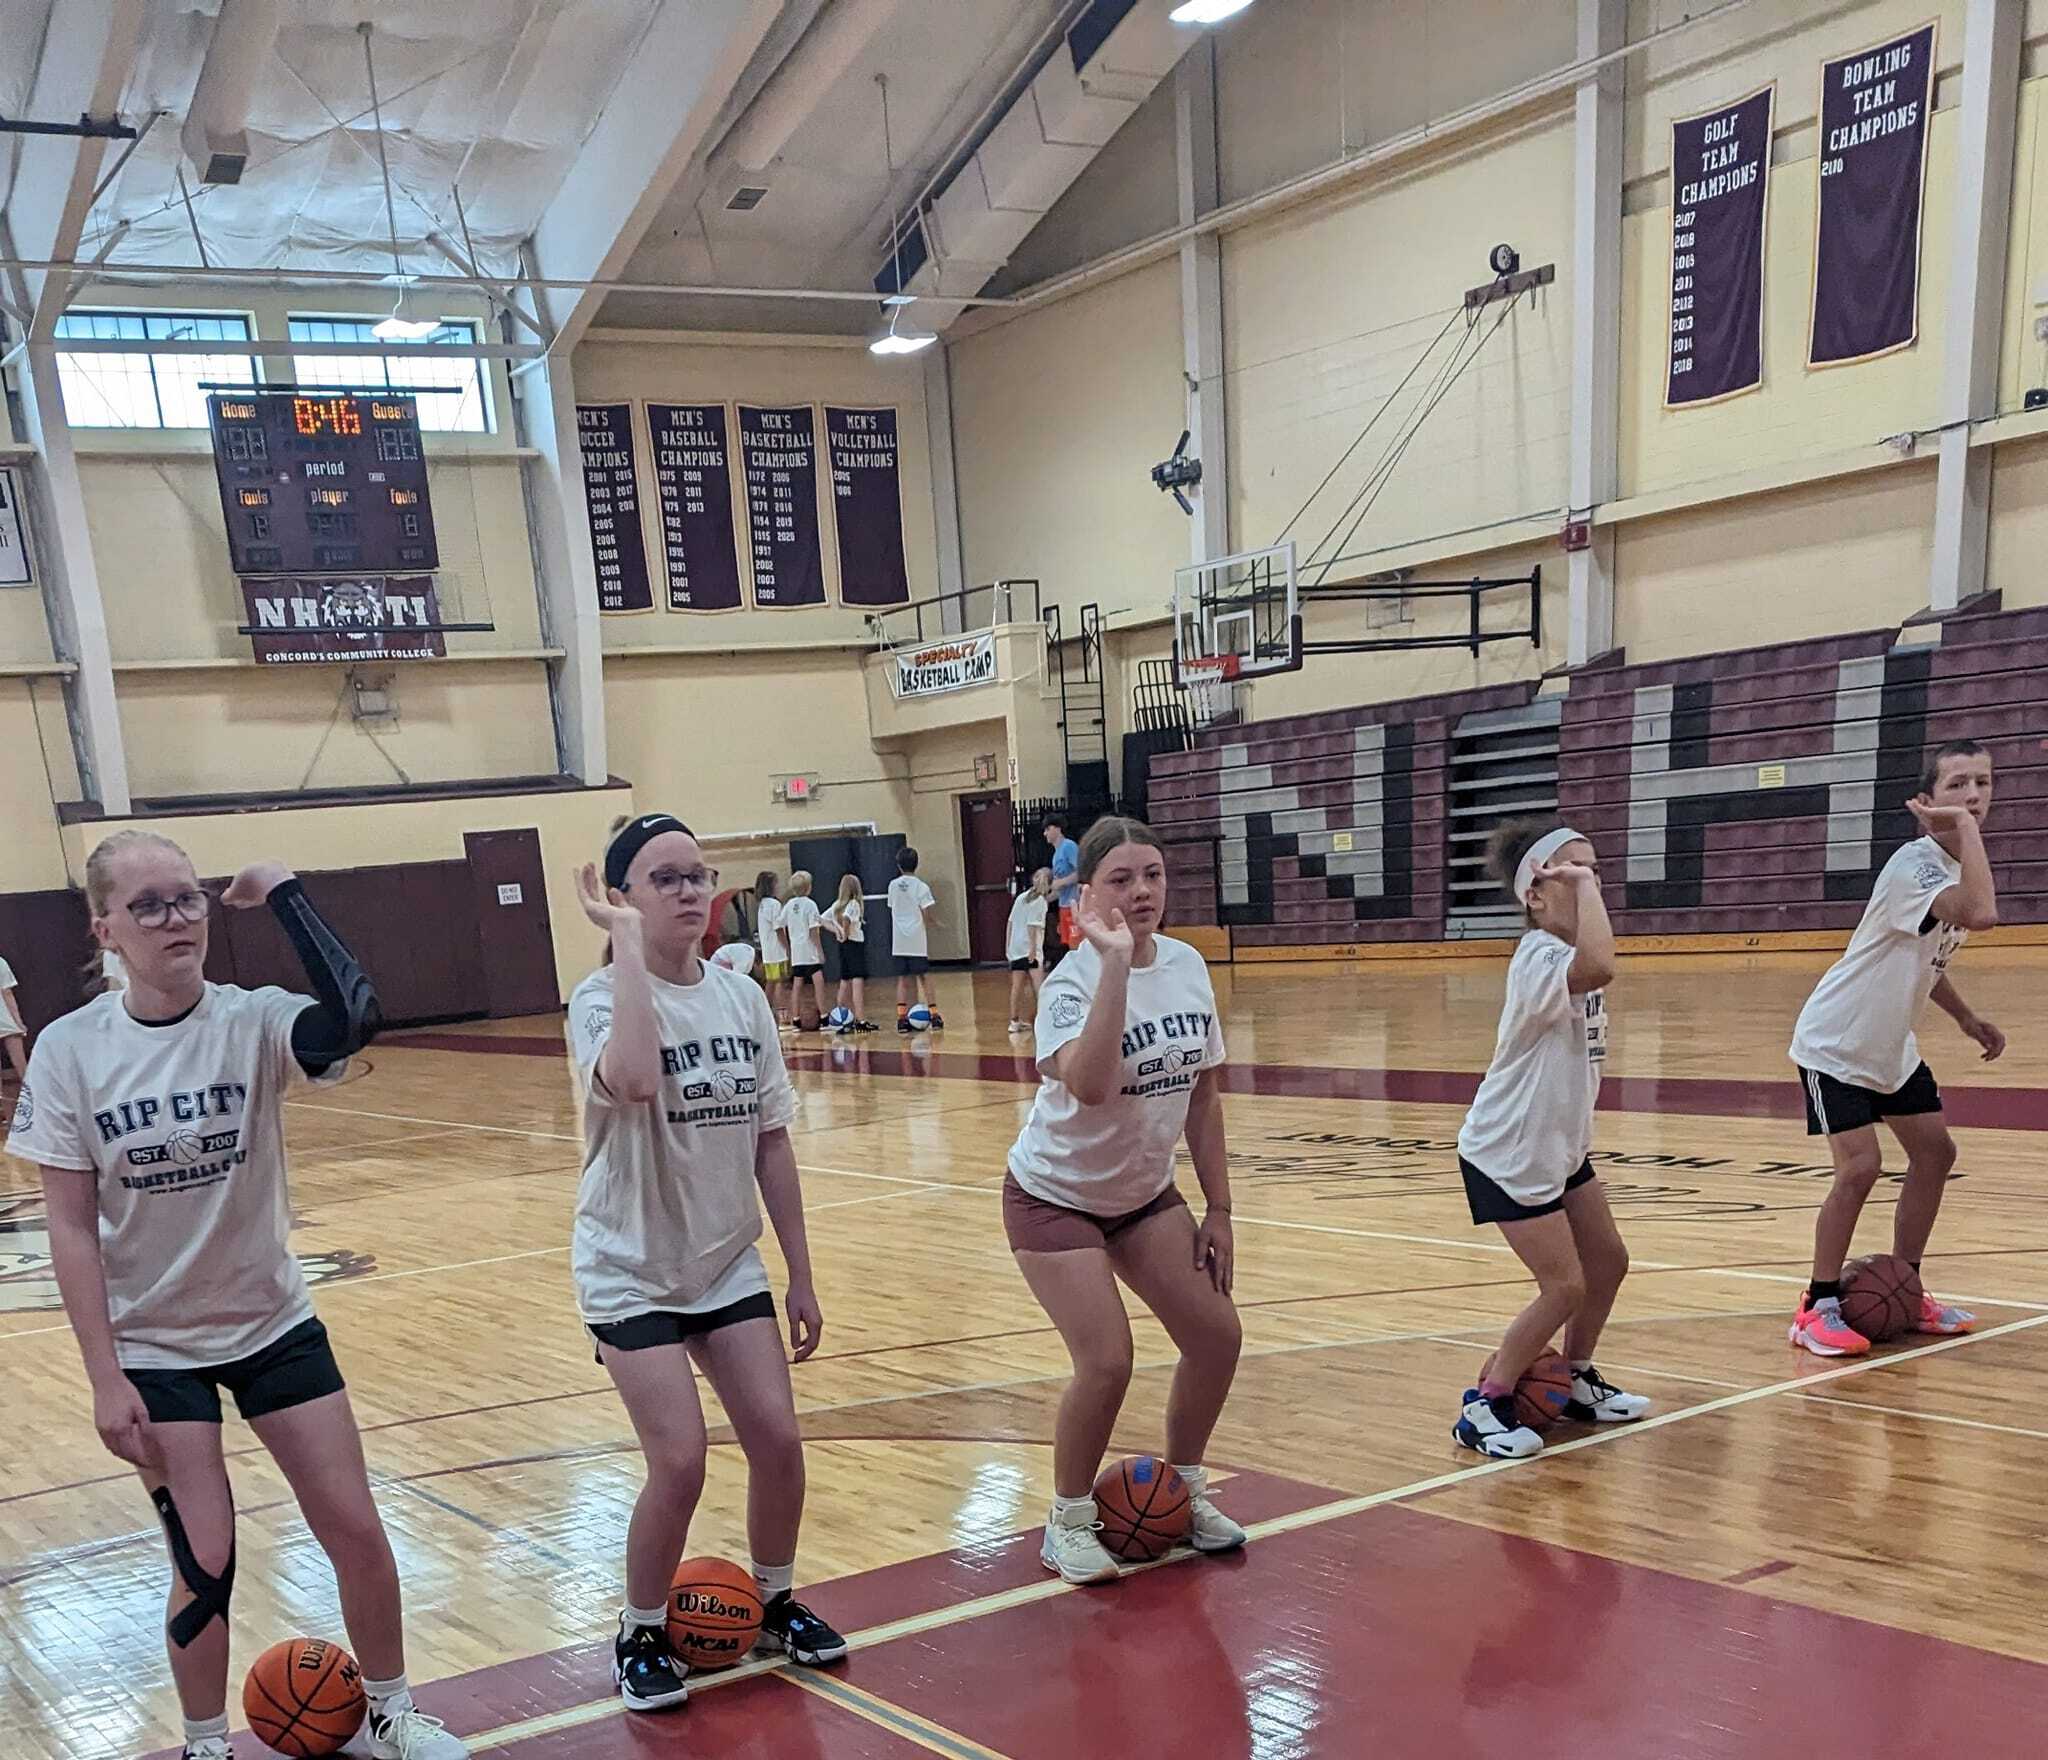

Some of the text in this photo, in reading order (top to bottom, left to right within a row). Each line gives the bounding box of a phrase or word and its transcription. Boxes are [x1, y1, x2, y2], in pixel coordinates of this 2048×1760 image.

[1842, 45, 1911, 88] BOWLING
[1853, 80, 1896, 115] TEAM
[1704, 114, 1739, 144] GOLF
[1829, 102, 1917, 151] CHAMPIONS
[1701, 142, 1740, 172] TEAM
[1681, 161, 1758, 205] CHAMPIONS
[221, 402, 257, 419] Home
[671, 411, 704, 426] MEN'S
[761, 414, 792, 429] MEN'S
[846, 415, 877, 430] MEN'S
[581, 432, 615, 447] OCCER
[661, 431, 718, 446] BASEBALL
[743, 431, 813, 449] BASKETBALL
[831, 431, 896, 449] VOLLEYBALL
[661, 451, 723, 467] CHAMPIONS
[751, 452, 808, 468] CHAMPIONS
[836, 452, 893, 468] CHAMPIONS
[305, 461, 346, 478] period
[239, 488, 417, 506] fouls player fouls
[590, 487, 610, 498] 2003
[266, 648, 435, 663] CONCORD'S COMMUNITY COLLEGE
[915, 641, 977, 667] SPECIALTY
[900, 651, 992, 692] BASKETBALL CAMP
[1122, 1012, 1212, 1058] RIP CITY
[660, 1040, 700, 1075] RIP
[94, 1096, 160, 1144] RIP
[677, 1592, 750, 1620] Wilson
